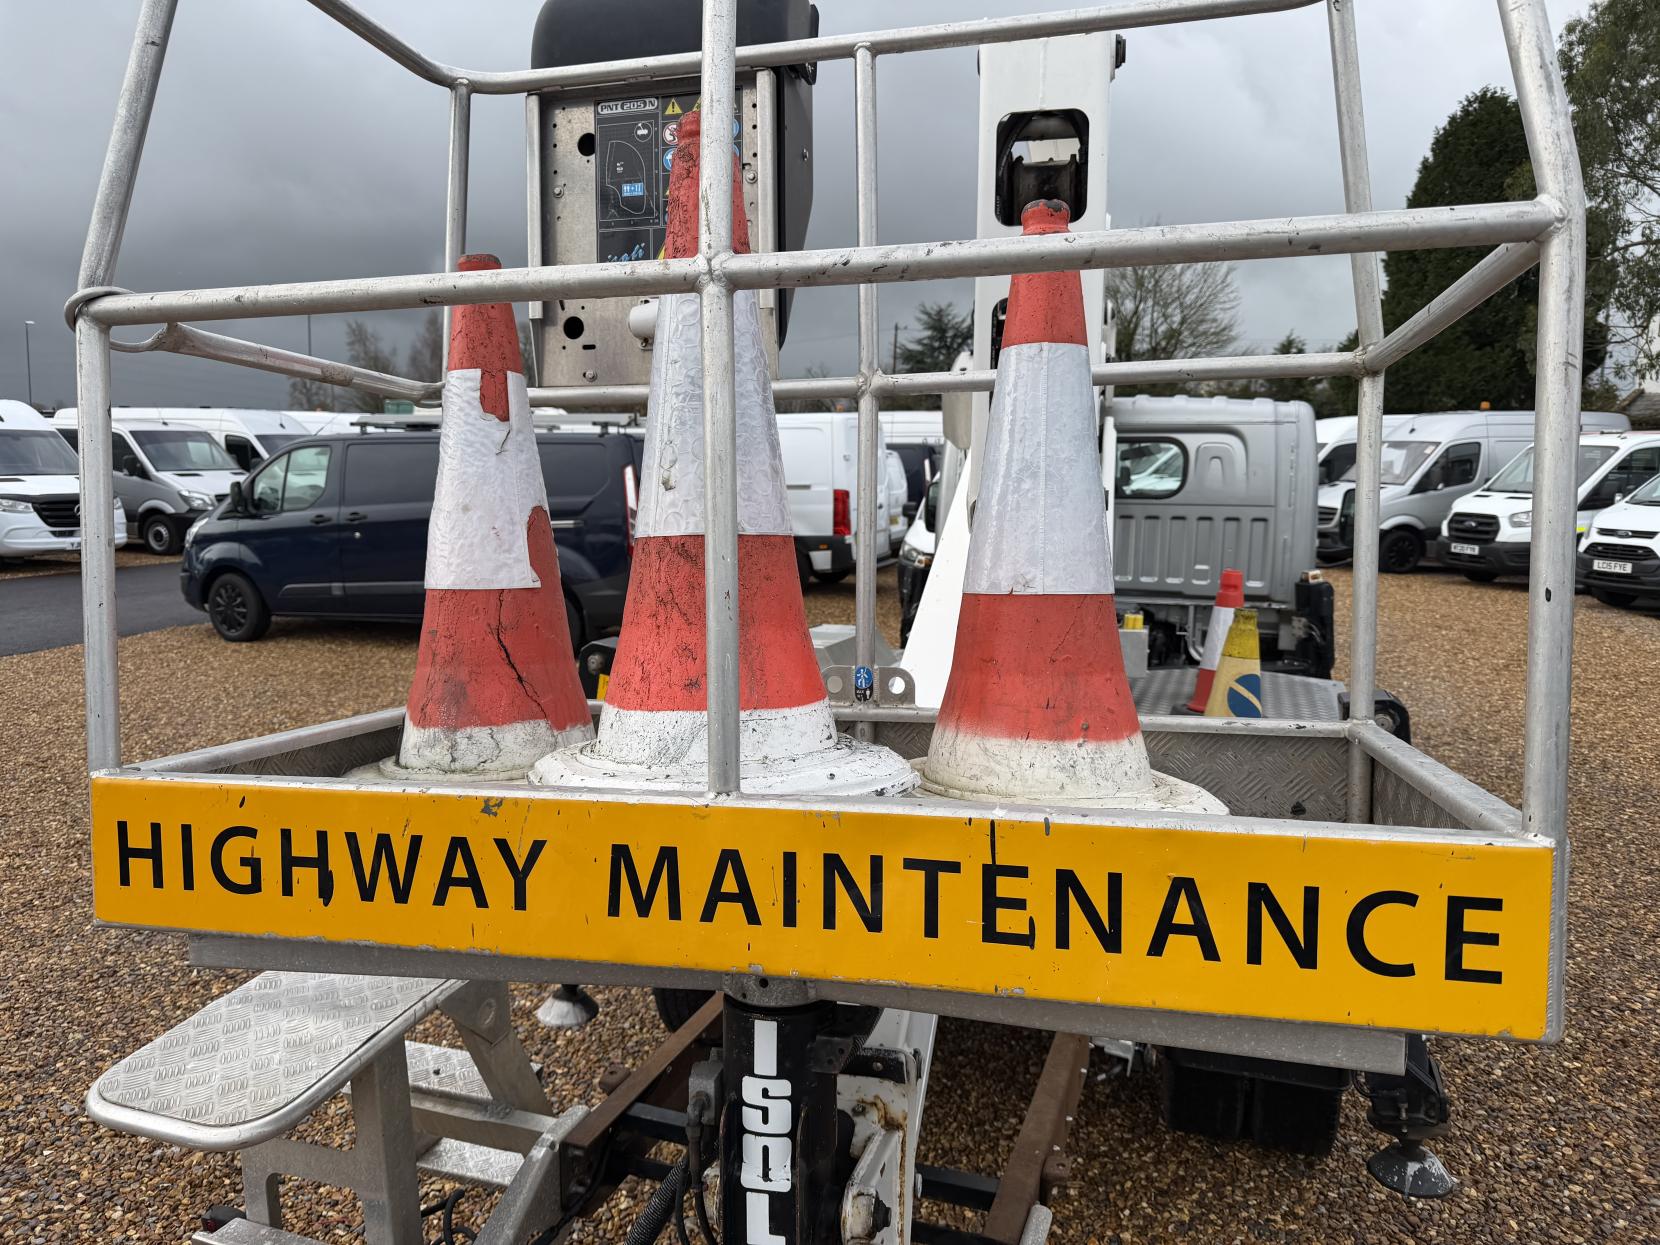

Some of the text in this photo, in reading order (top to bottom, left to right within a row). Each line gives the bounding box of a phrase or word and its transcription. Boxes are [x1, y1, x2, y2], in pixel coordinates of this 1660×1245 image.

[600, 99, 656, 113] PNT 205 N
[1597, 561, 1628, 572] LC15 FYE
[116, 820, 1504, 985] HIGHWAY MAINTENANCE
